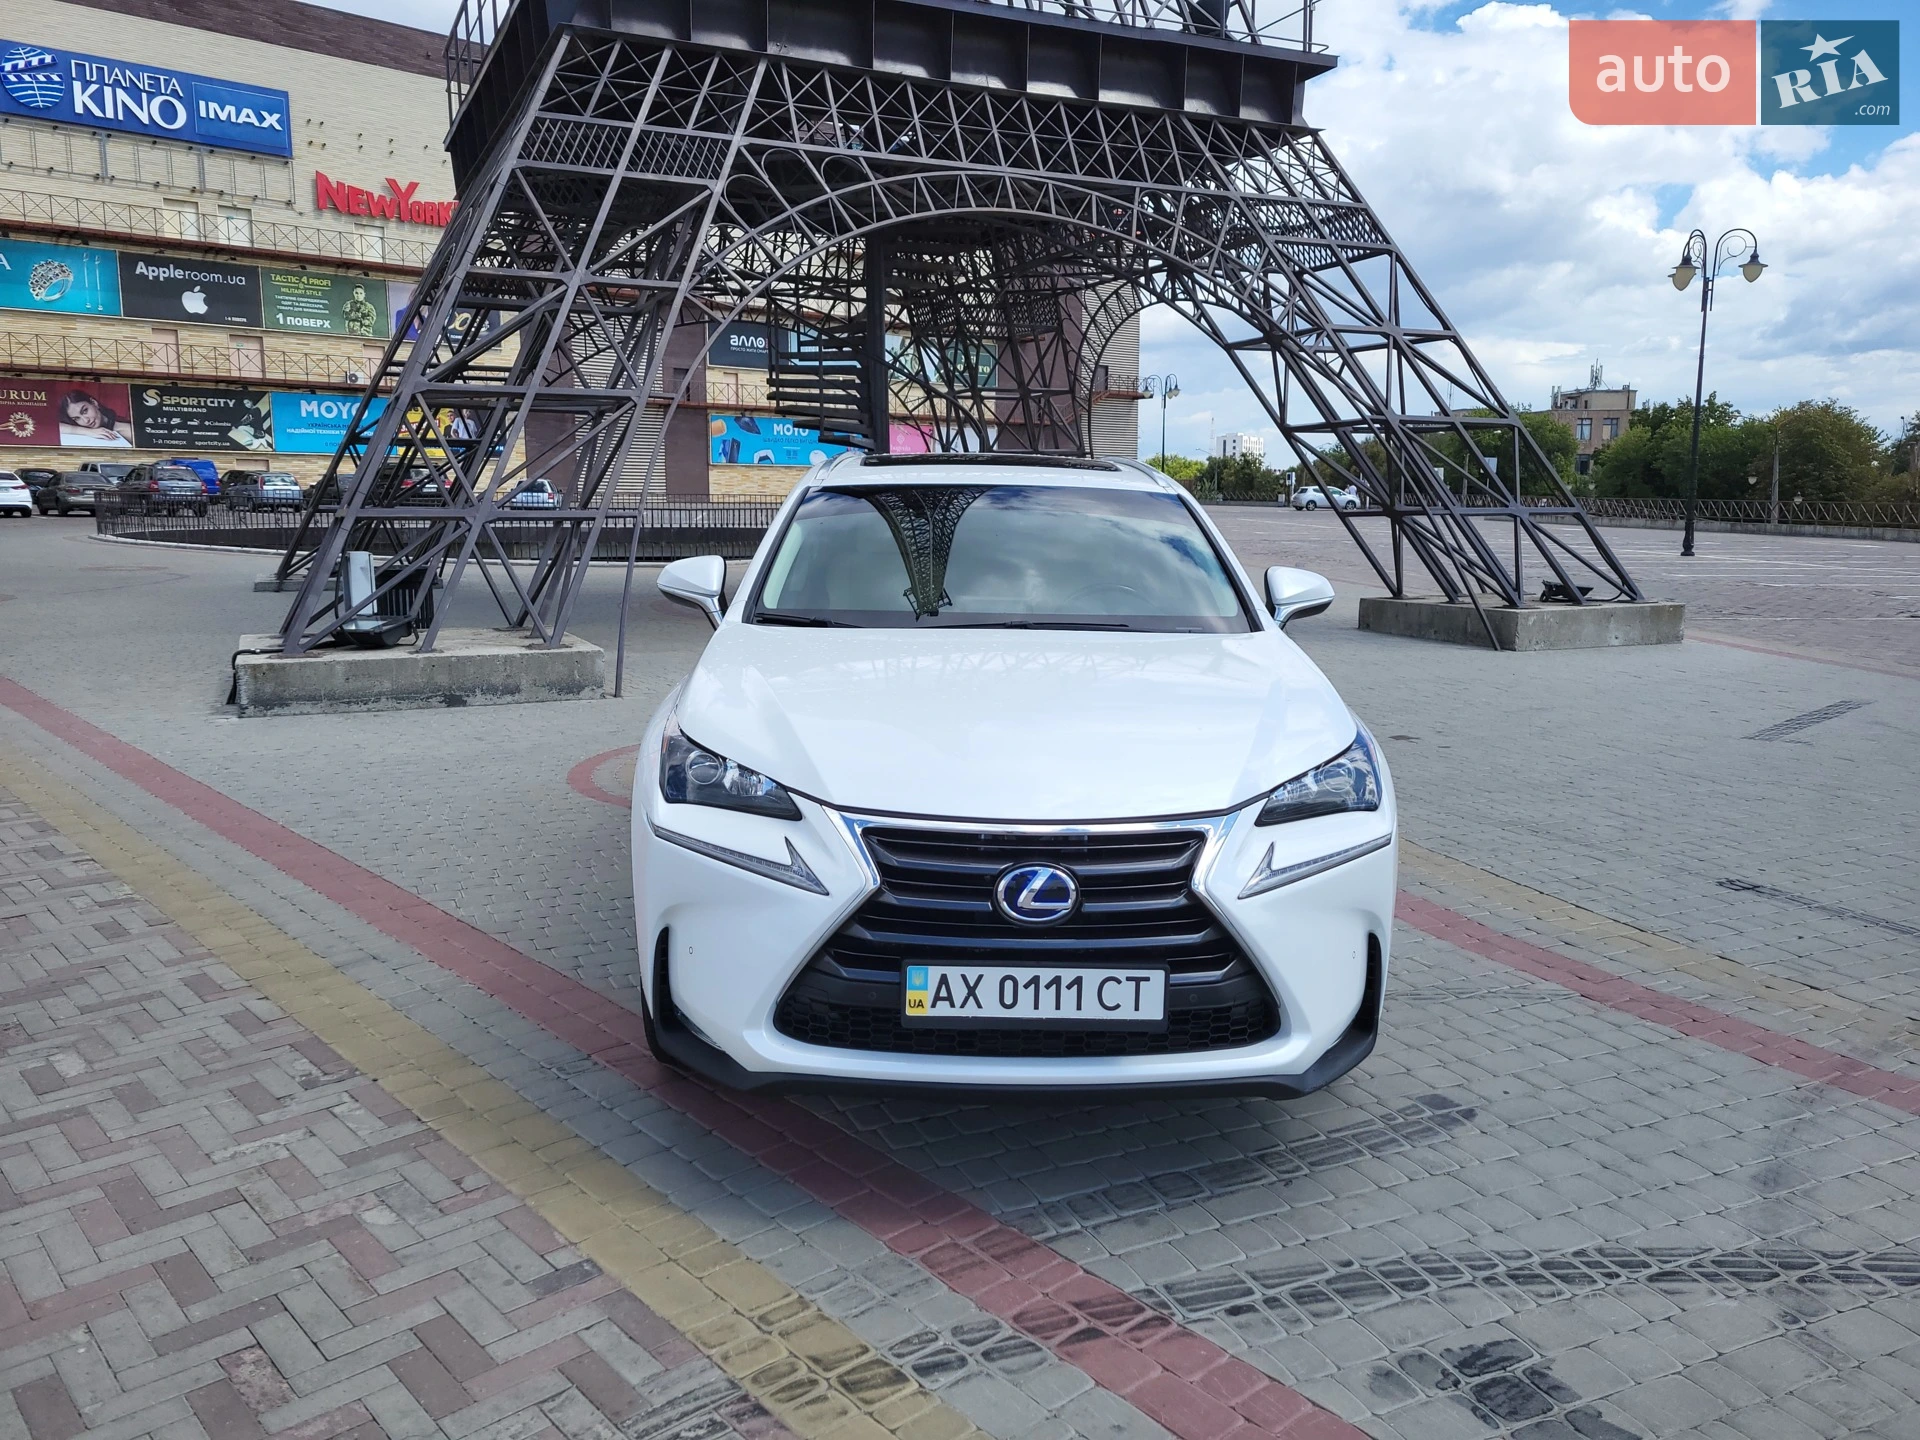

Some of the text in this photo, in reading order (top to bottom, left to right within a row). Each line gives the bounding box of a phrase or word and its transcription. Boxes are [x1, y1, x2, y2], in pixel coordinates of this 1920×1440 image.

[72, 81, 187, 130] KINO
[199, 100, 283, 131] IMAX
[135, 261, 246, 286] Appleroom.ua
[270, 273, 331, 287] TACTIC 4 PROFI
[276, 312, 331, 328] 1 ПОВЕРХ
[162, 395, 236, 408] SPORTCITY
[908, 973, 1151, 1012] UA AX 0111 CT
